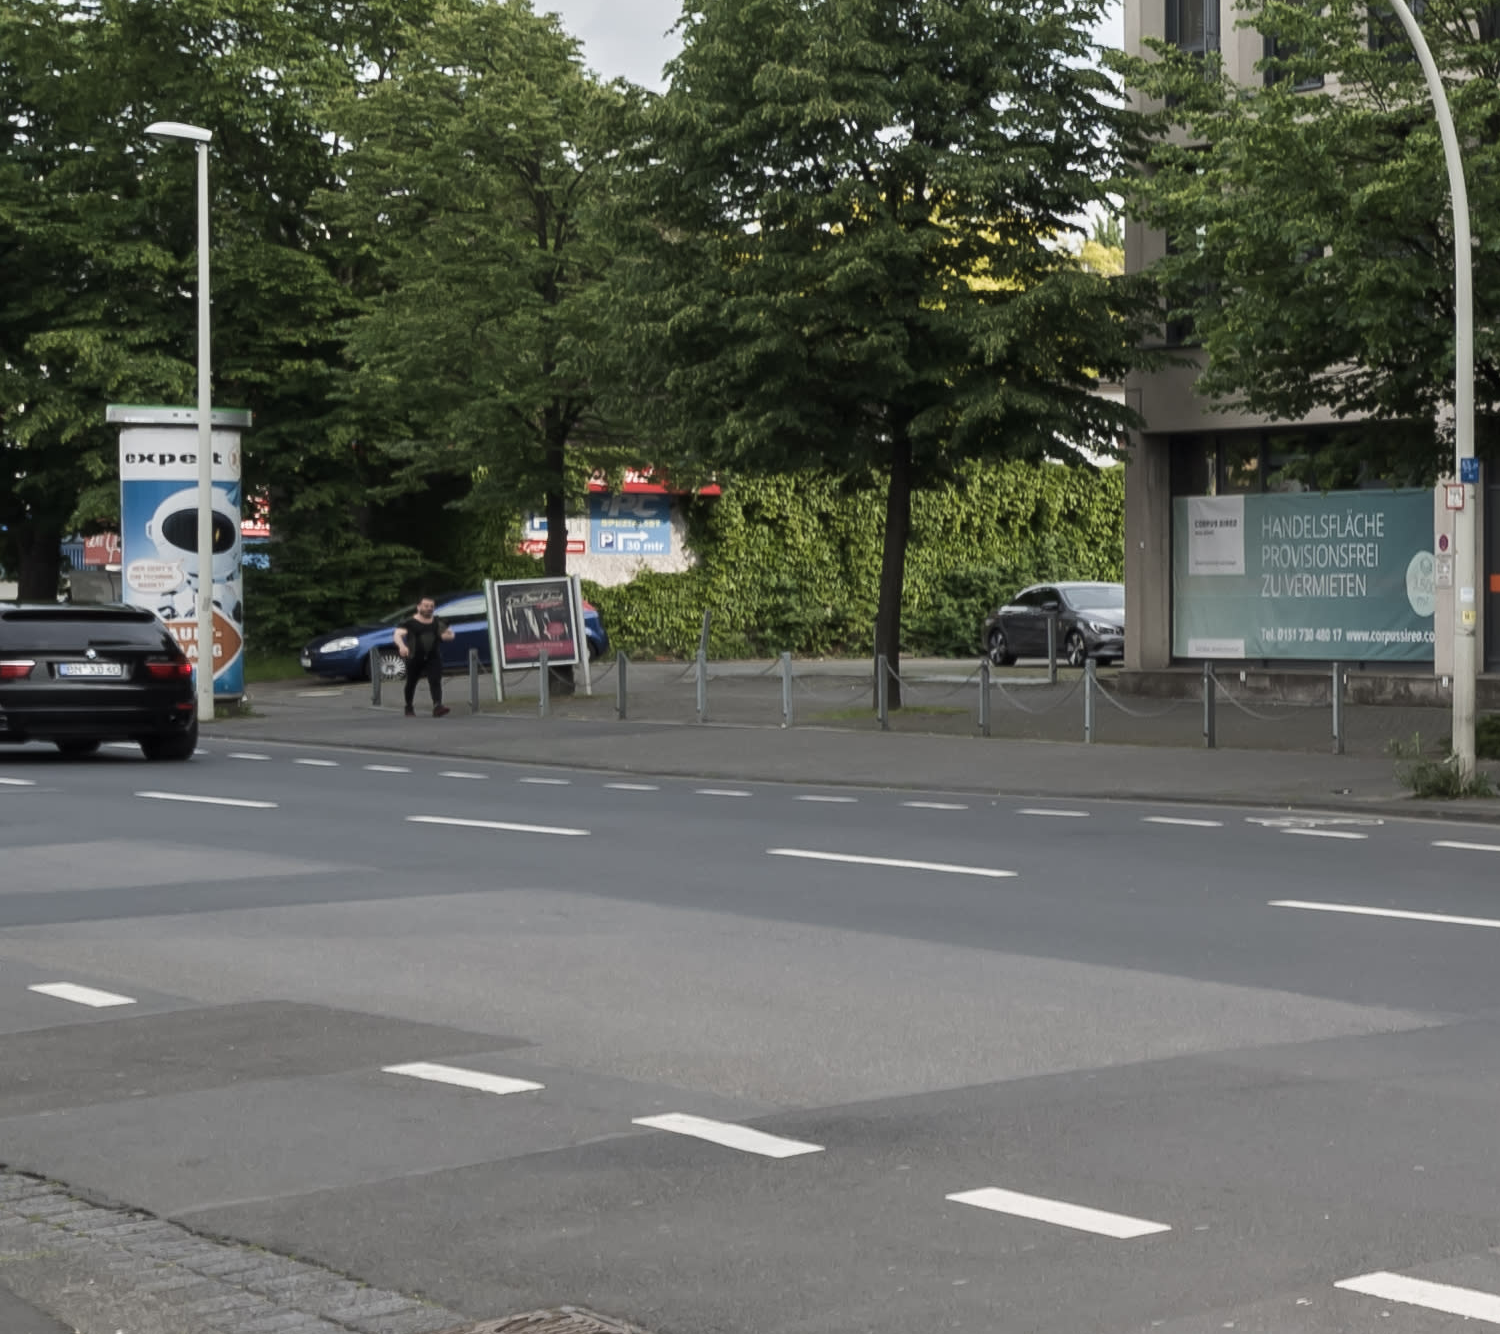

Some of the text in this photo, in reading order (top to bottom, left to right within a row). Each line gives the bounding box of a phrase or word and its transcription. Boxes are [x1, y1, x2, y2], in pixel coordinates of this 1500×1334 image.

[124, 450, 222, 466] expet
[1262, 510, 1385, 539] HANDELSFLÄCHE
[626, 541, 665, 551] 30 mtr
[1262, 543, 1379, 568] PROVISIONSFREI
[1262, 573, 1367, 598] ZU VERMIETEN
[1332, 628, 1342, 642] 17
[1346, 628, 1435, 645] www.corpussireo.co
